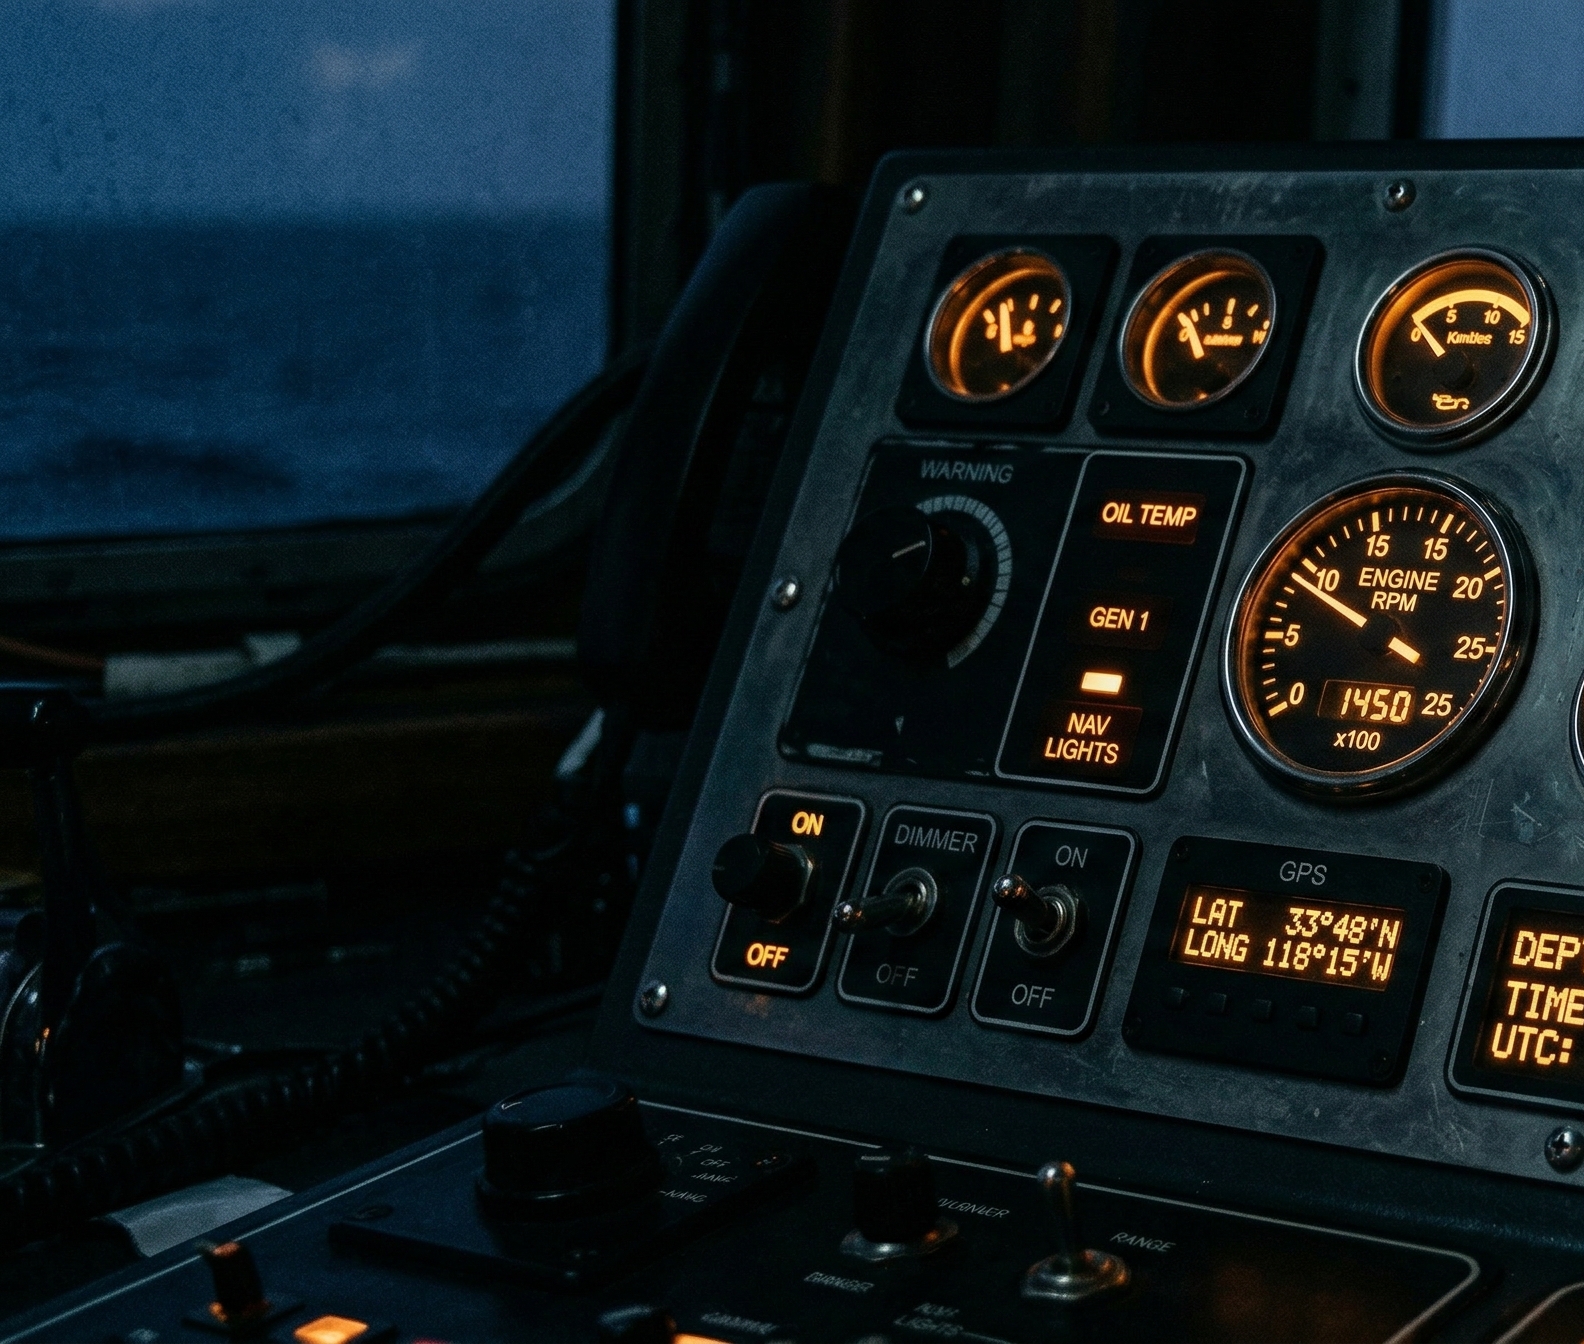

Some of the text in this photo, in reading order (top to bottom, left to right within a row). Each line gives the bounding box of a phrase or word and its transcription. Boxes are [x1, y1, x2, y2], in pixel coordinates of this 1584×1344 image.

[1446, 309, 1457, 323] 5
[1484, 310, 1500, 324] 10
[1411, 328, 1421, 342] 0
[1509, 330, 1525, 344] 15
[920, 459, 1015, 484] WARNING
[1102, 502, 1197, 527] OIL TEMP
[1366, 535, 1391, 557] 15
[1424, 538, 1449, 560] 15
[1317, 569, 1340, 591] 10
[1359, 567, 1441, 591] ENGINE
[1453, 577, 1484, 599] 20
[1371, 591, 1417, 612] RPM
[1089, 607, 1151, 631] GEN 1
[1284, 624, 1301, 646] 5
[1454, 636, 1486, 659] 25
[1289, 682, 1305, 705] 0
[1341, 687, 1412, 723] 1450
[1422, 693, 1454, 716] 25
[1067, 713, 1112, 735] NAV
[1045, 737, 1120, 764] LIGHTS
[1333, 730, 1381, 750] x100
[791, 811, 824, 837] ON
[894, 824, 979, 854] DIMMER
[1055, 845, 1089, 869] ON
[1279, 860, 1327, 886] GPS
[1192, 896, 1243, 928] LAT
[746, 942, 789, 969] OFF
[1184, 929, 1250, 962] LONG
[876, 963, 919, 988] OFF
[1011, 984, 1055, 1009] OFF
[1491, 1022, 1573, 1065] UTC:
[1111, 1232, 1176, 1253] RANGE
